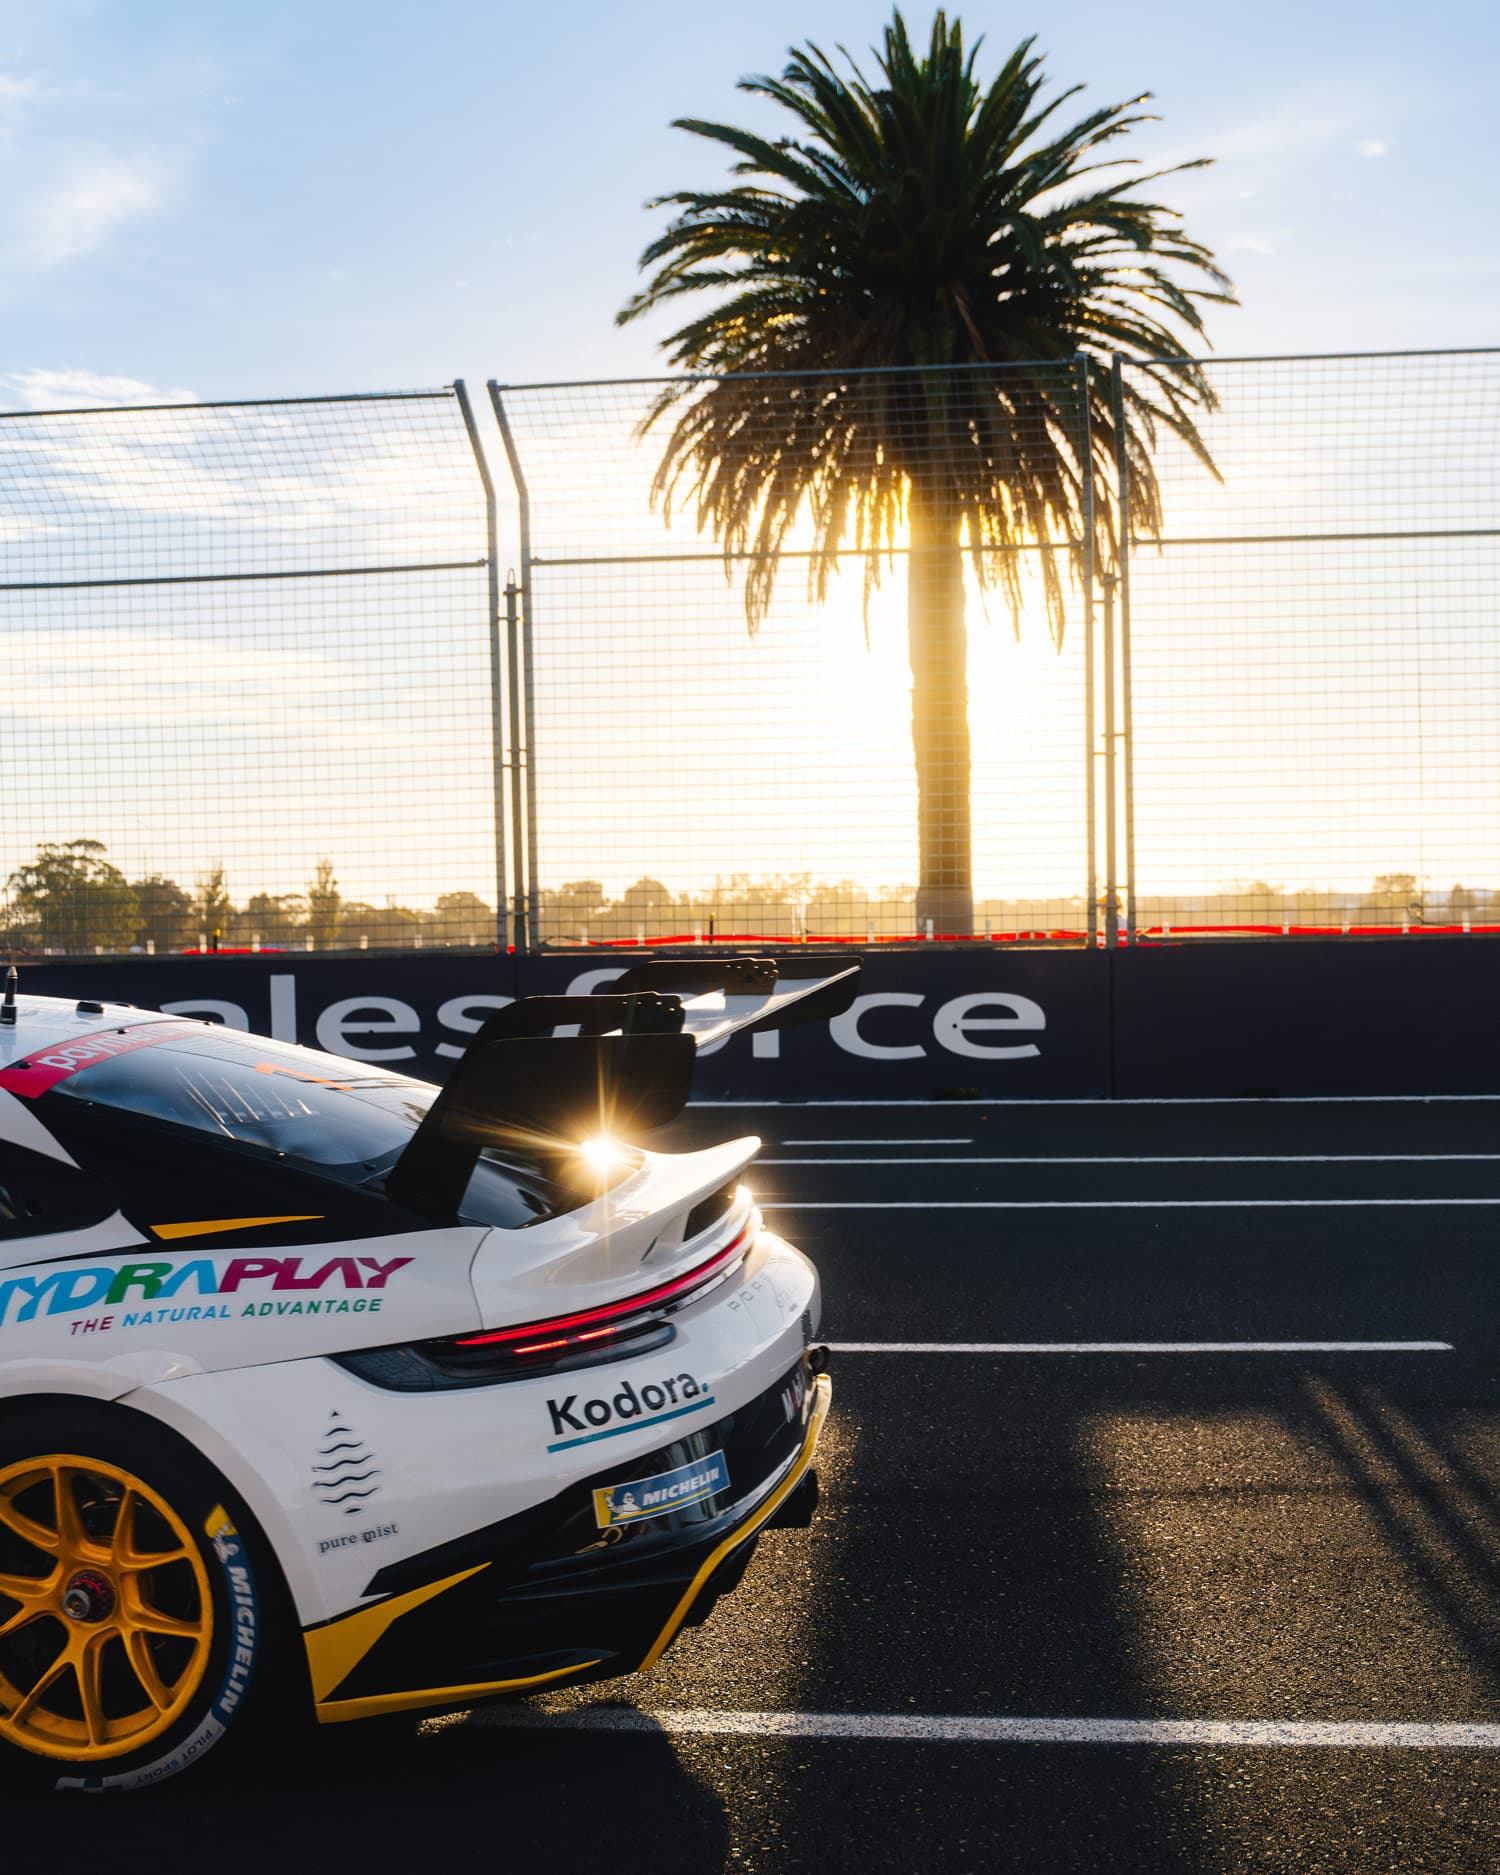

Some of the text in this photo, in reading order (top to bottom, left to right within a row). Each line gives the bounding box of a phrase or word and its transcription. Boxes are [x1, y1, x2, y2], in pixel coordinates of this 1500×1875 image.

[71, 1298, 383, 1335] THE NATURAL ADVANTAGE
[642, 1467, 720, 1506] MICHELIN
[319, 1524, 399, 1553] pure mist
[219, 1566, 255, 1714] MICHELIN
[182, 1728, 213, 1761] PILOT
